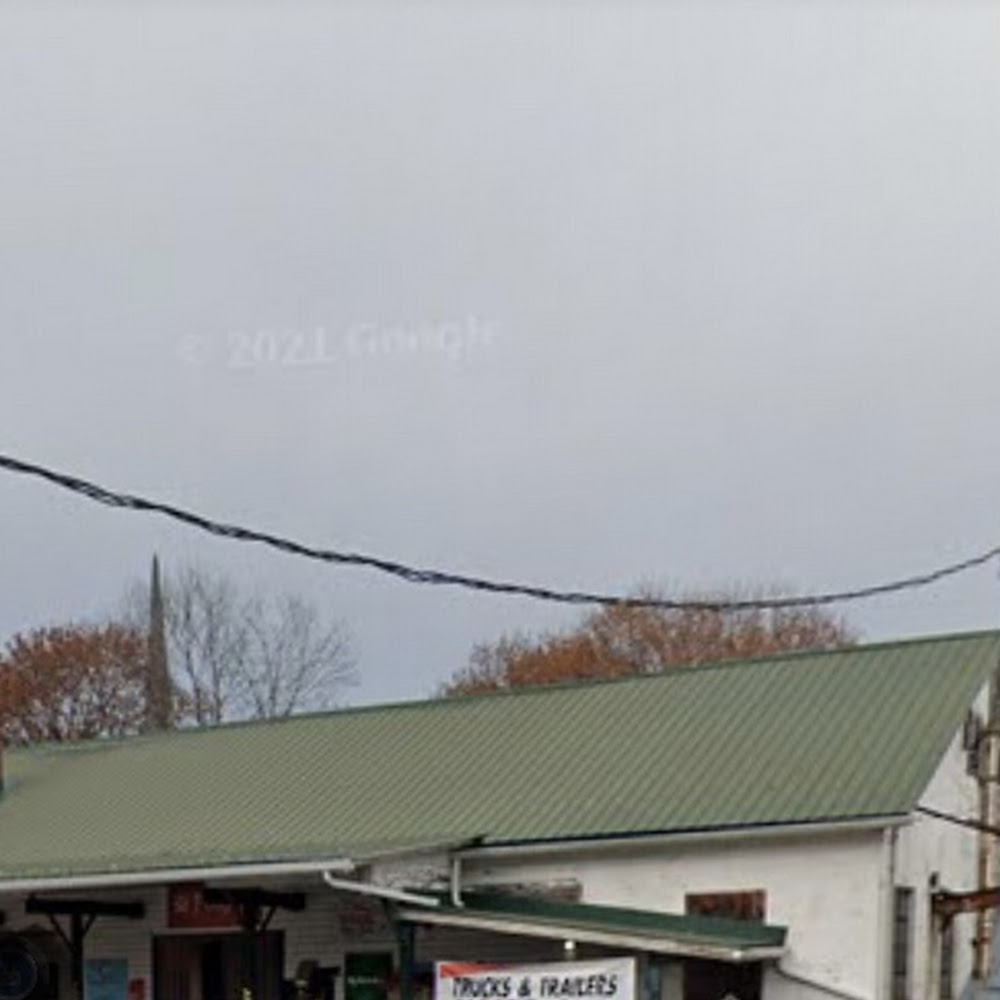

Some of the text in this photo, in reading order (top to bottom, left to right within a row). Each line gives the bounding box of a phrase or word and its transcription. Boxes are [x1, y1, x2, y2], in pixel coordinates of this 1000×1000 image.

[453, 974, 618, 998] TRUCKS & TRAILERS
